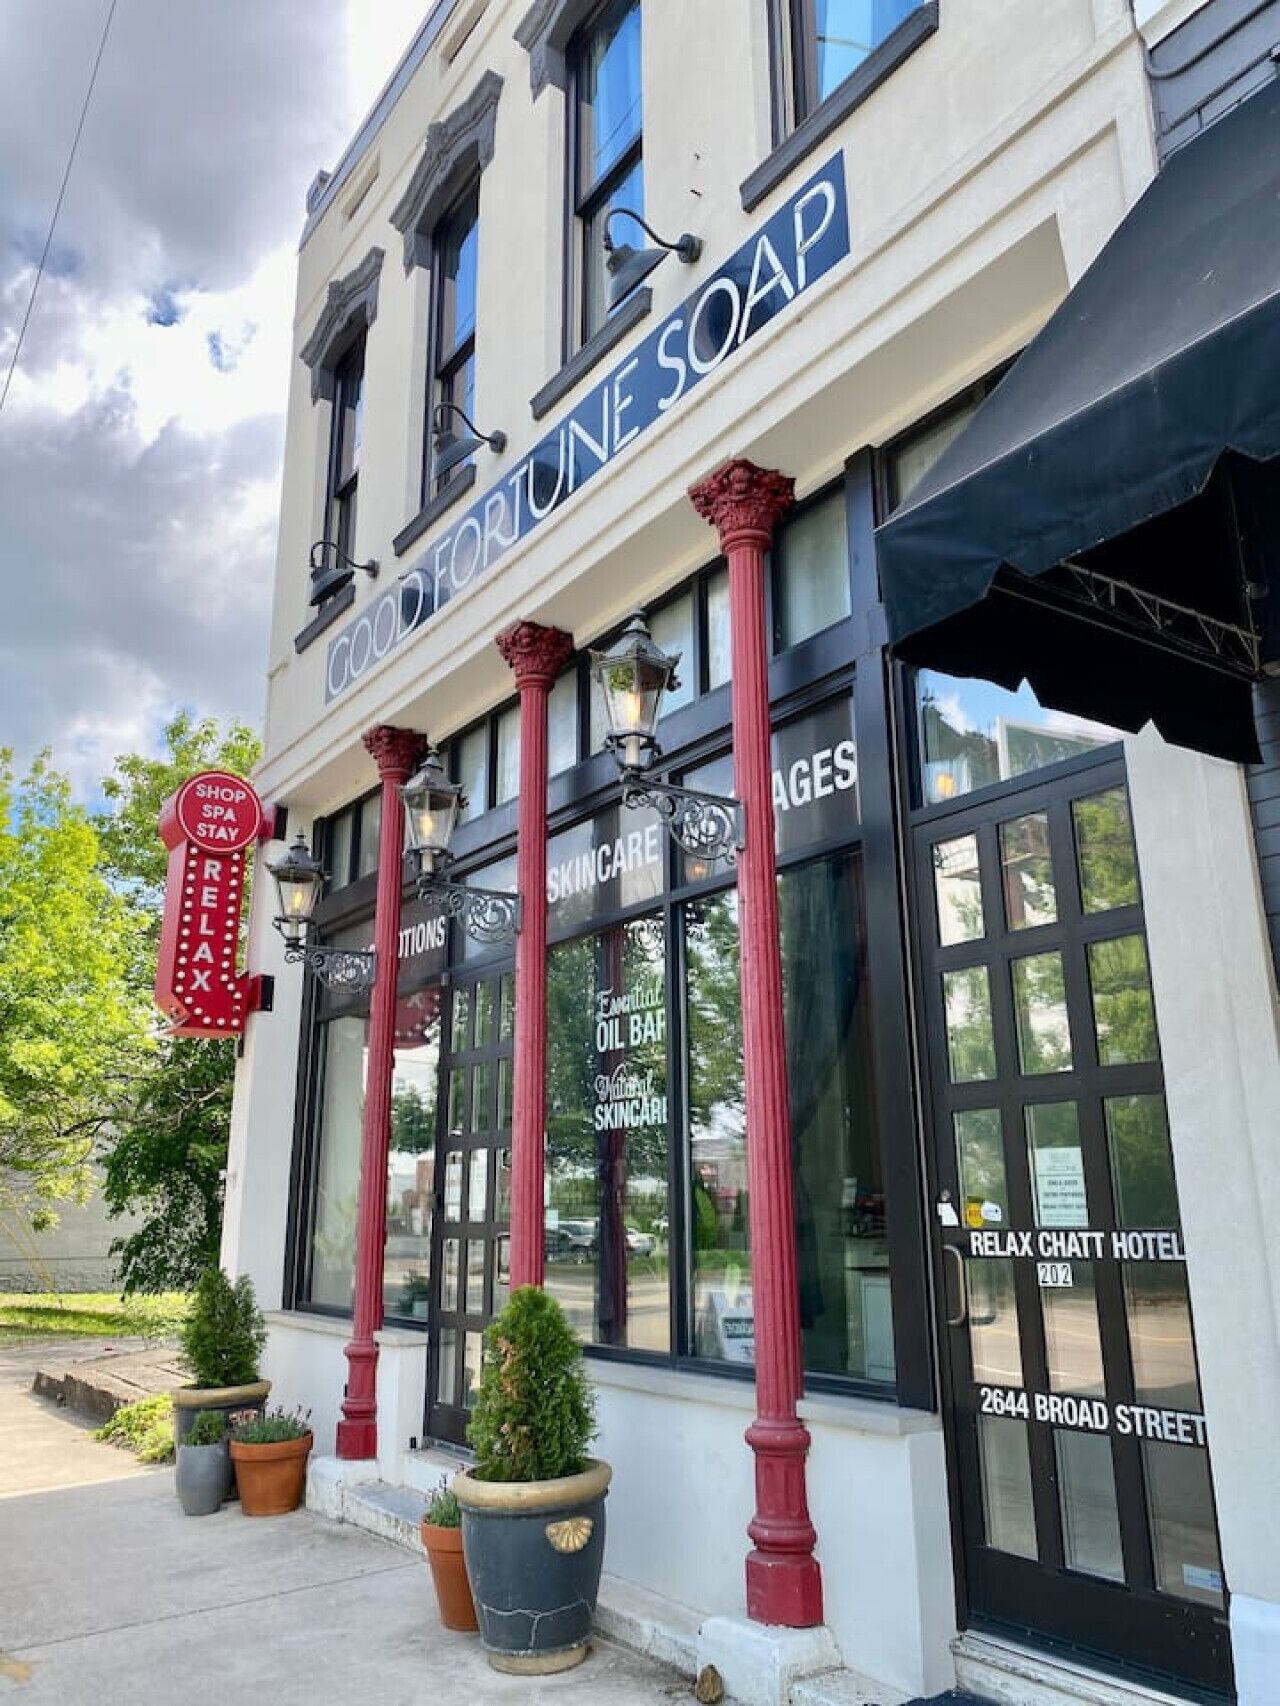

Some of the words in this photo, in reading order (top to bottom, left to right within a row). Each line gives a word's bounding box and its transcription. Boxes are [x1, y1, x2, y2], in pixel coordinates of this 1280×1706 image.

[328, 569, 424, 695] GOOD
[433, 357, 641, 614] FORTUNE
[656, 180, 836, 411] SOAP
[195, 783, 247, 804] SHOP
[201, 804, 236, 822] SPA
[196, 822, 240, 842] STAY
[547, 822, 660, 902] SKINCARE
[190, 859, 222, 992] RELAX
[596, 1017, 625, 1053] OIL
[970, 1231, 1034, 1257] RELAX
[1039, 1231, 1105, 1259] CHATT
[1112, 1231, 1187, 1261] HOTEL
[1040, 1264, 1071, 1285] 202
[980, 1387, 1029, 1418] 2644
[1035, 1393, 1109, 1431] BROAD
[1116, 1406, 1208, 1446] STREET
